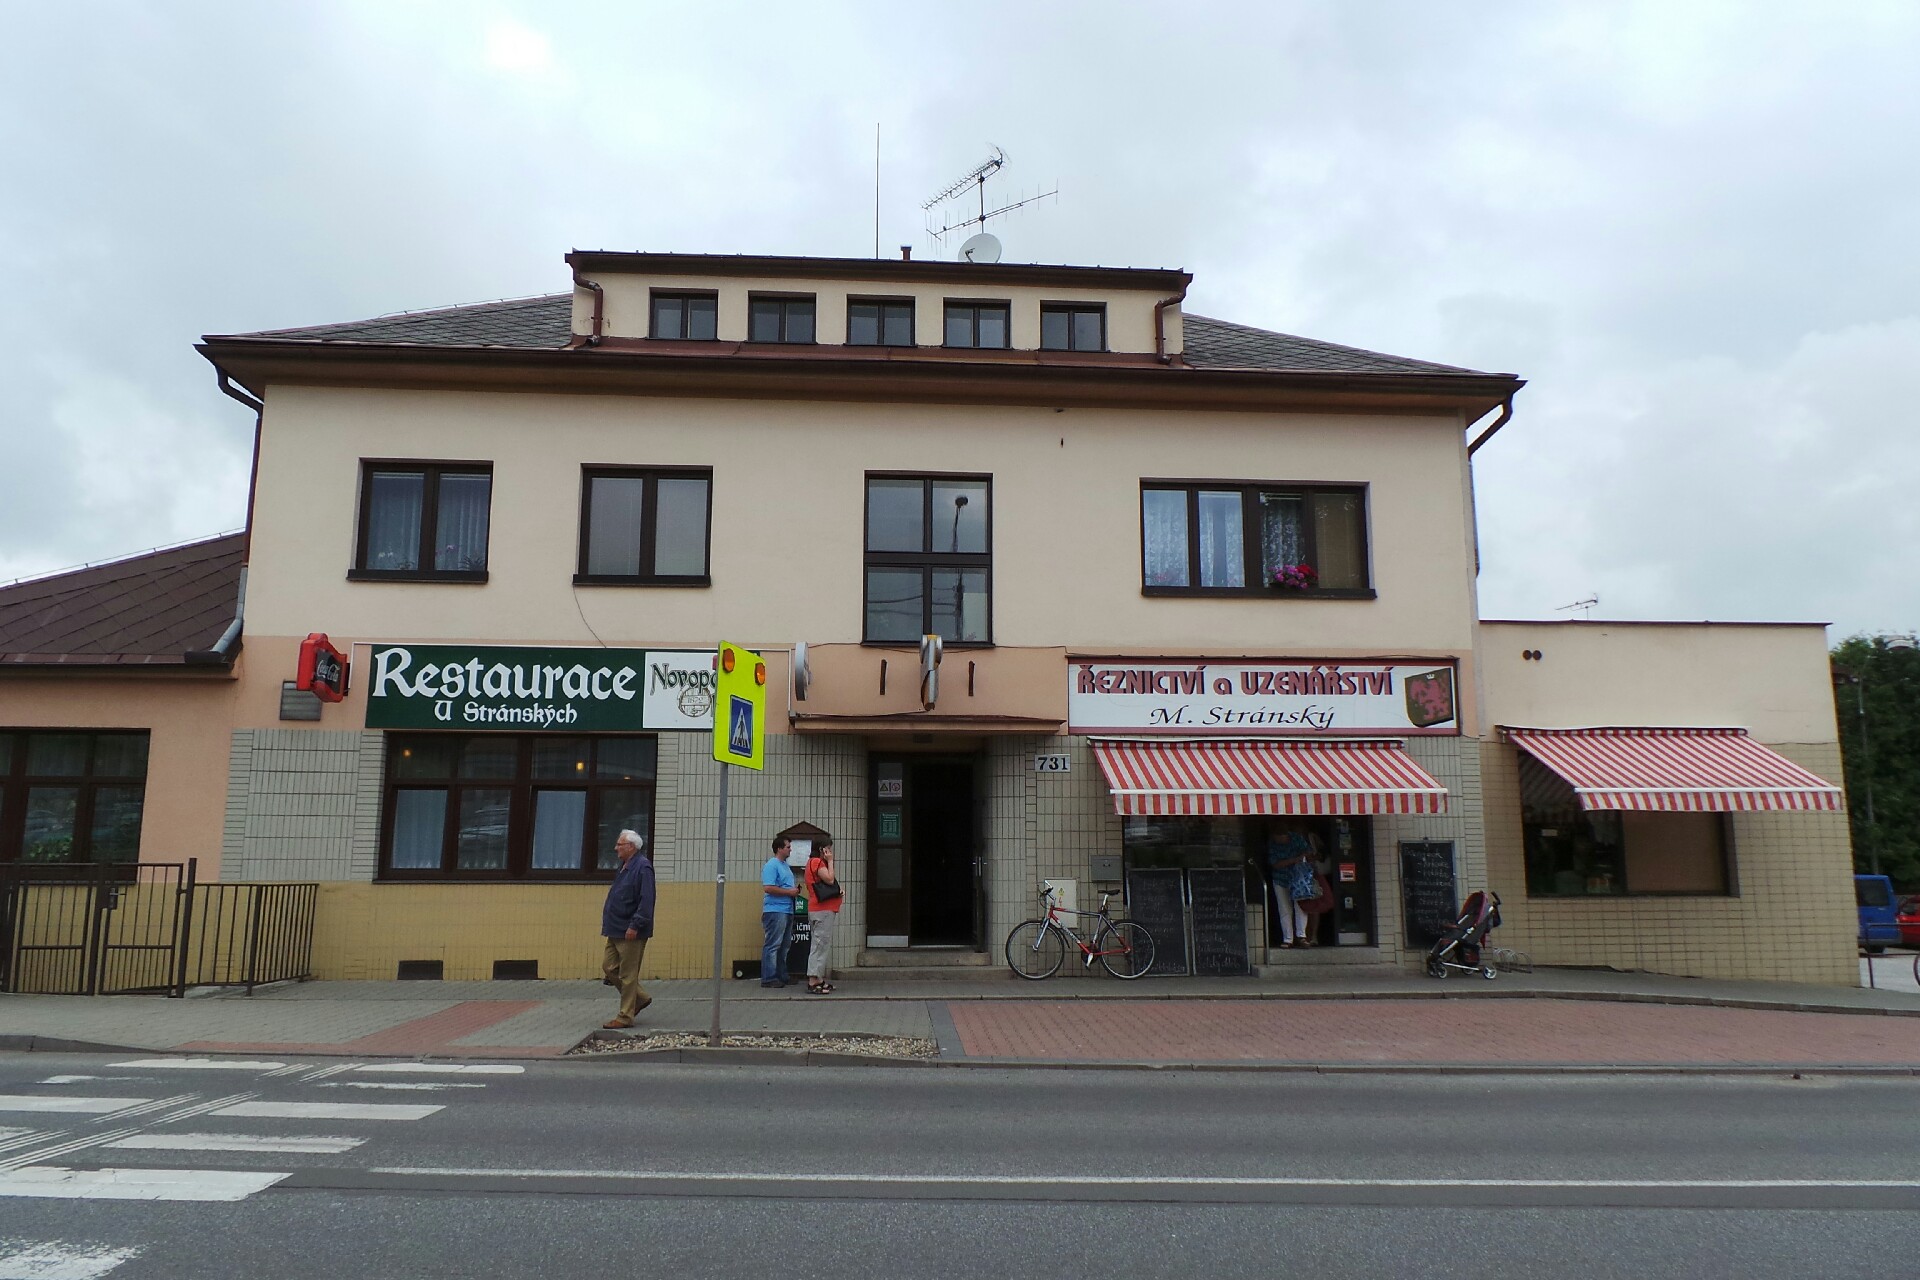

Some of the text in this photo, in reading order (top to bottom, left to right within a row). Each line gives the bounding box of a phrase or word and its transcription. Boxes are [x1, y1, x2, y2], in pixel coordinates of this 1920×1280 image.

[372, 648, 637, 700] Restaurace
[1077, 665, 1394, 696] ŘEZNICTVÍ a UZENÁŘSTVÍ
[434, 700, 578, 729] U Stránských
[1150, 704, 1335, 731] M. Stránský
[1038, 756, 1068, 770] 731
